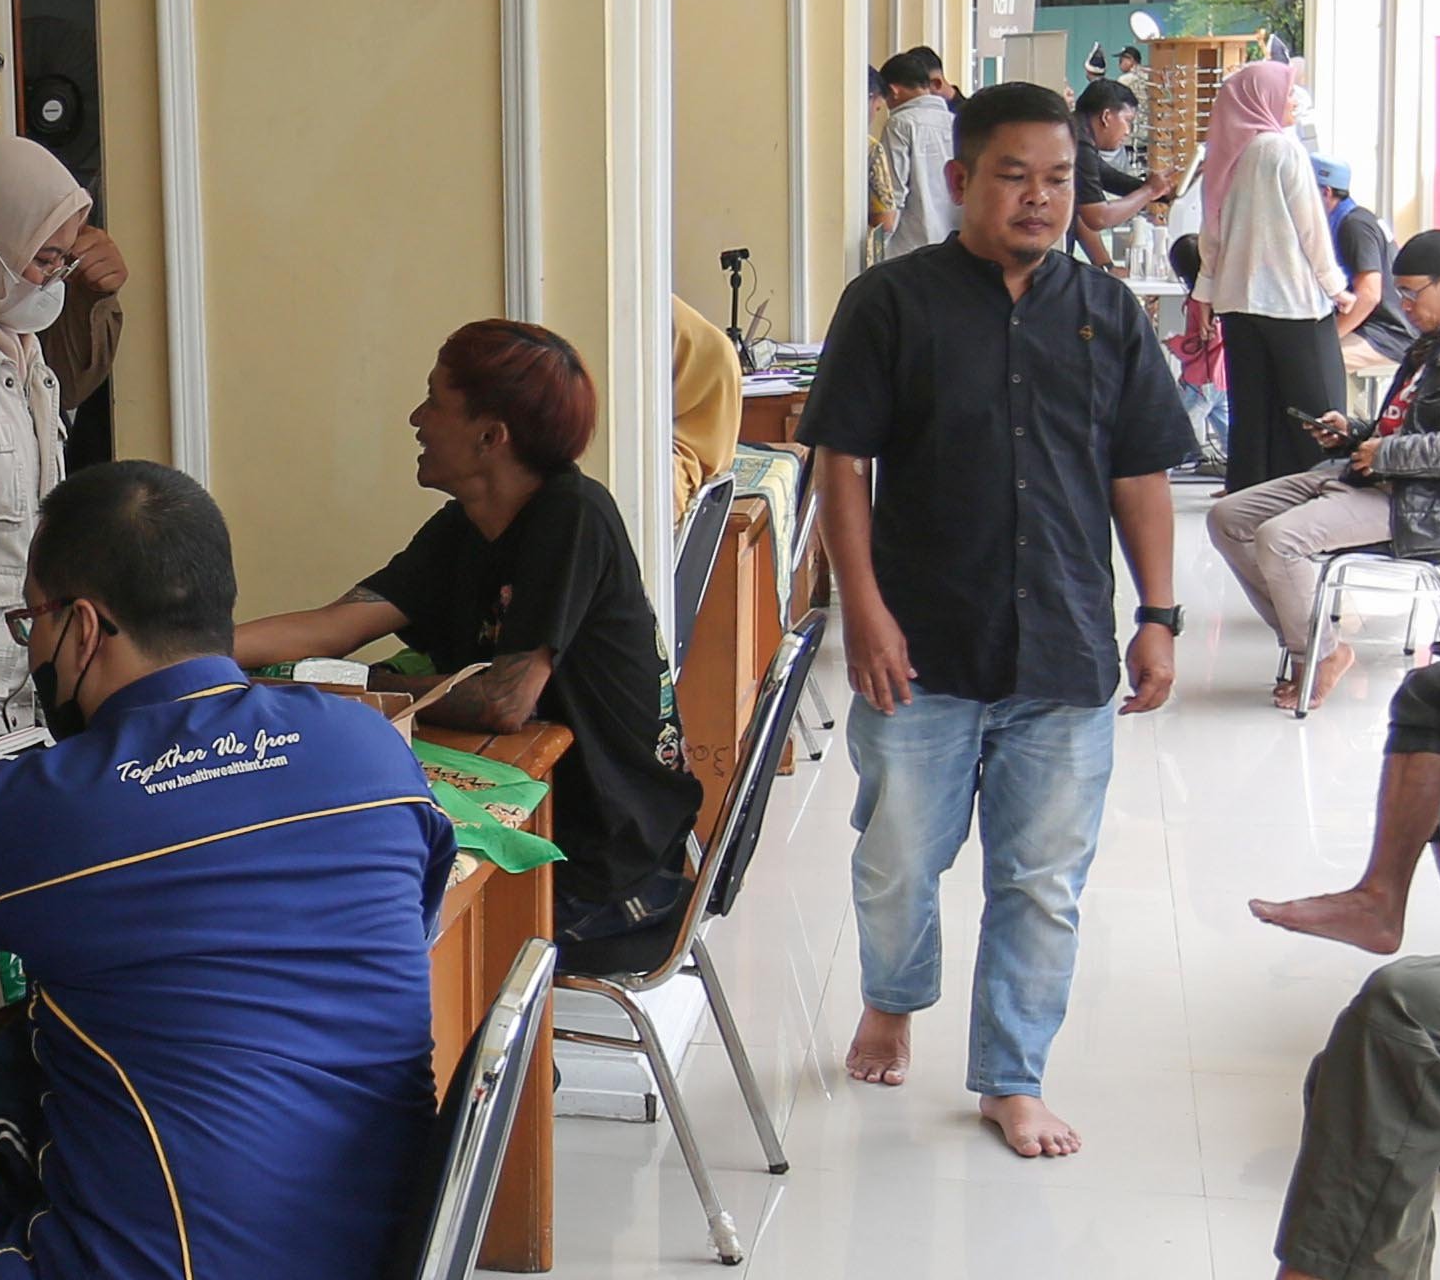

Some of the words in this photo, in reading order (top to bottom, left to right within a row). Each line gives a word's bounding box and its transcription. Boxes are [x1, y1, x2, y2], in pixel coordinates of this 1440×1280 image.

[116, 743, 207, 785] Together
[212, 731, 248, 757] We
[254, 728, 300, 760] Grow
[144, 754, 288, 795] www.healthwealthint.com
